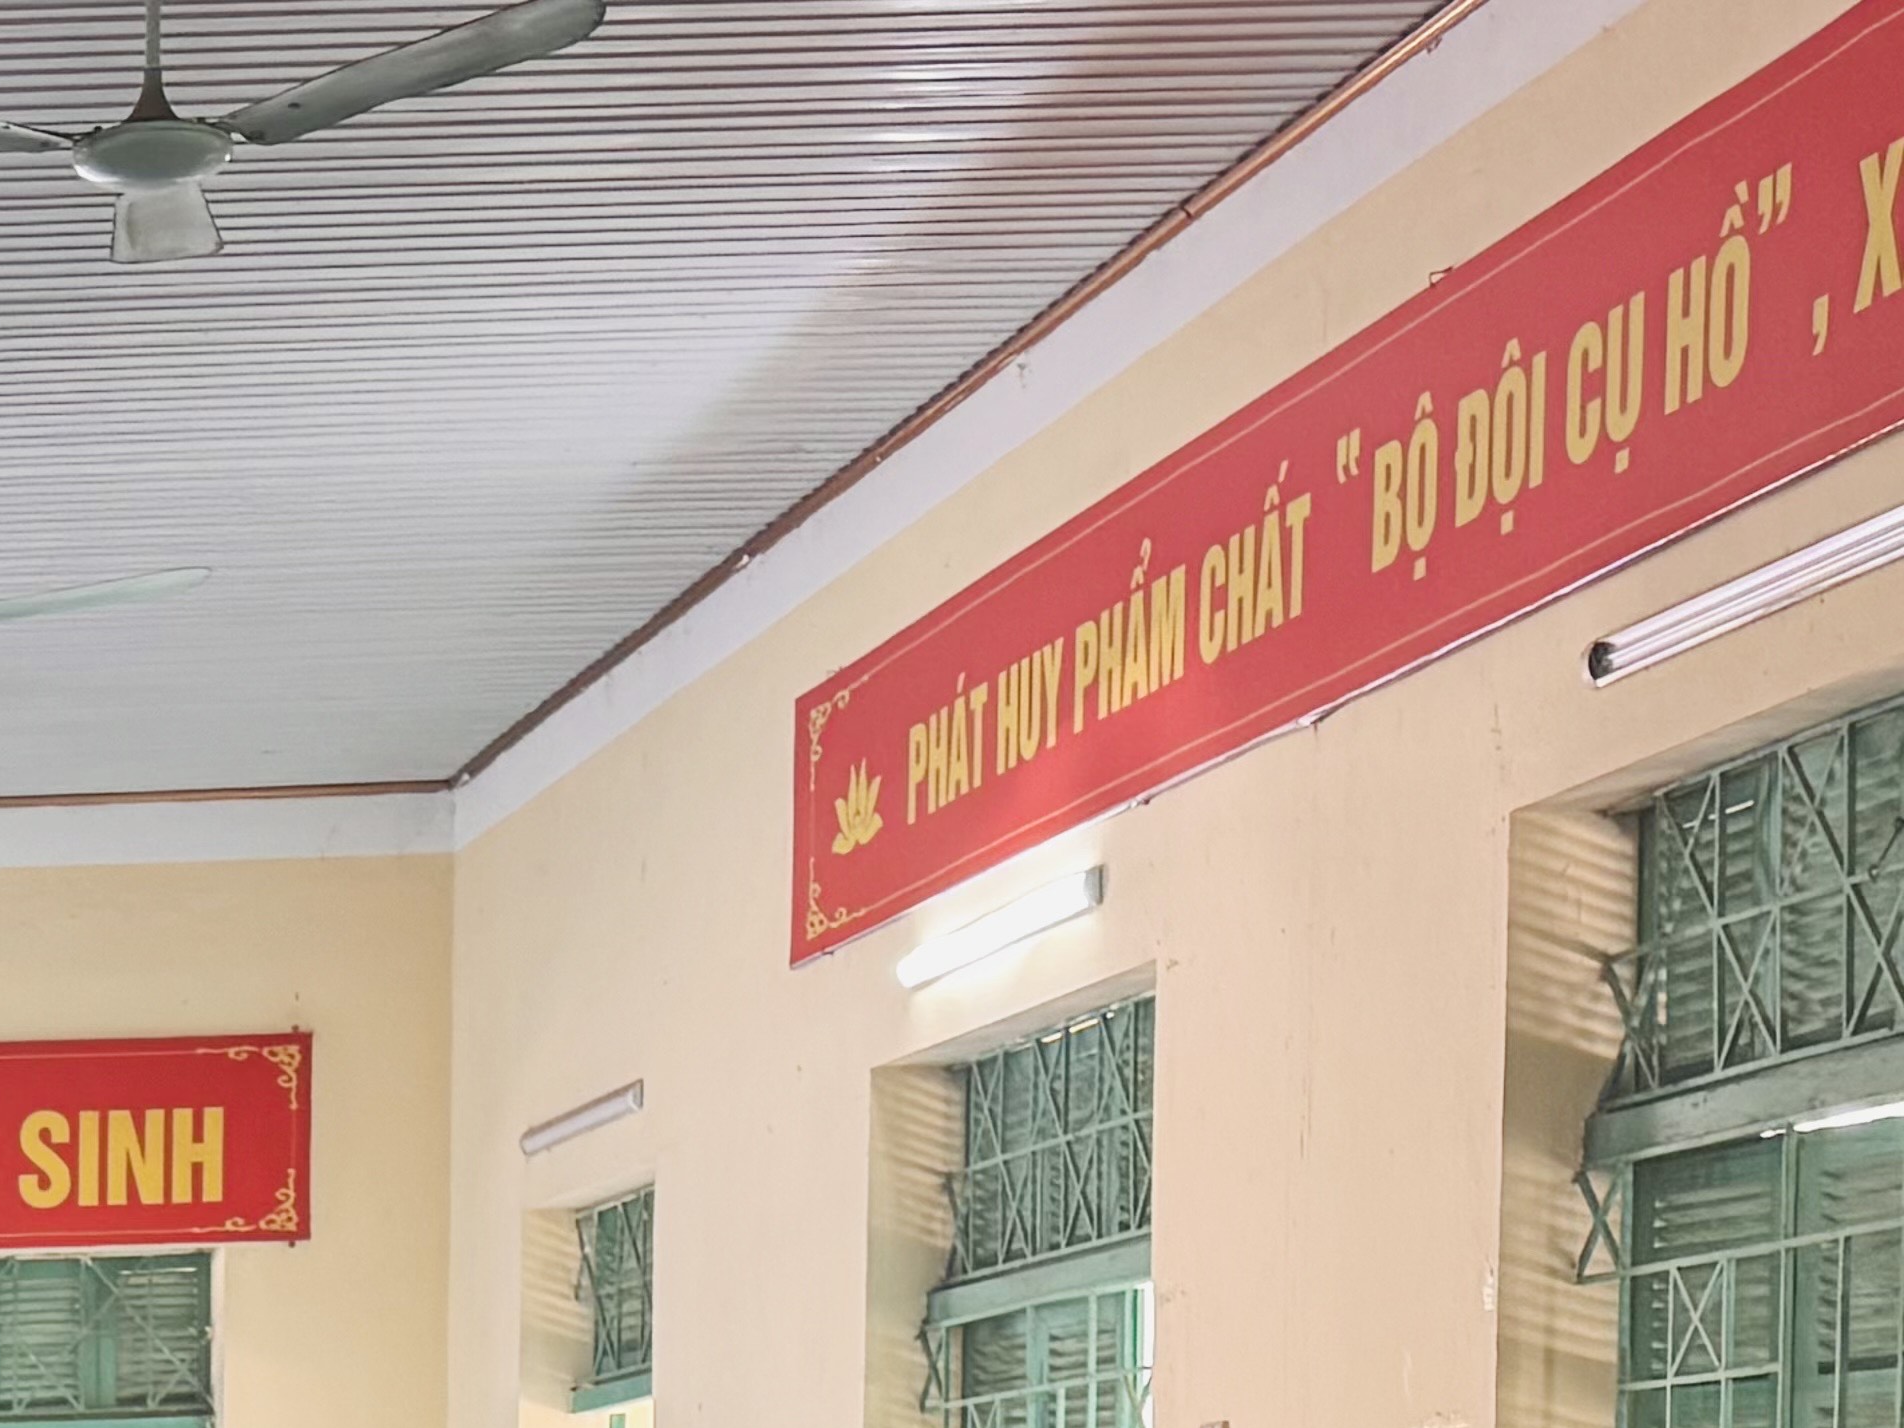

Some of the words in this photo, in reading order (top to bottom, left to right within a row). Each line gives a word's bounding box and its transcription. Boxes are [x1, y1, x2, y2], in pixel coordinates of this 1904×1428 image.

[908, 673, 988, 824] PHÁT
[997, 637, 1063, 775] HUY
[1073, 538, 1185, 734] PHẨM
[1199, 460, 1311, 664] CHẤT
[1455, 338, 1546, 534] ĐỘI
[1566, 292, 1644, 473] CỤ
[19, 1107, 223, 1208] SINH
